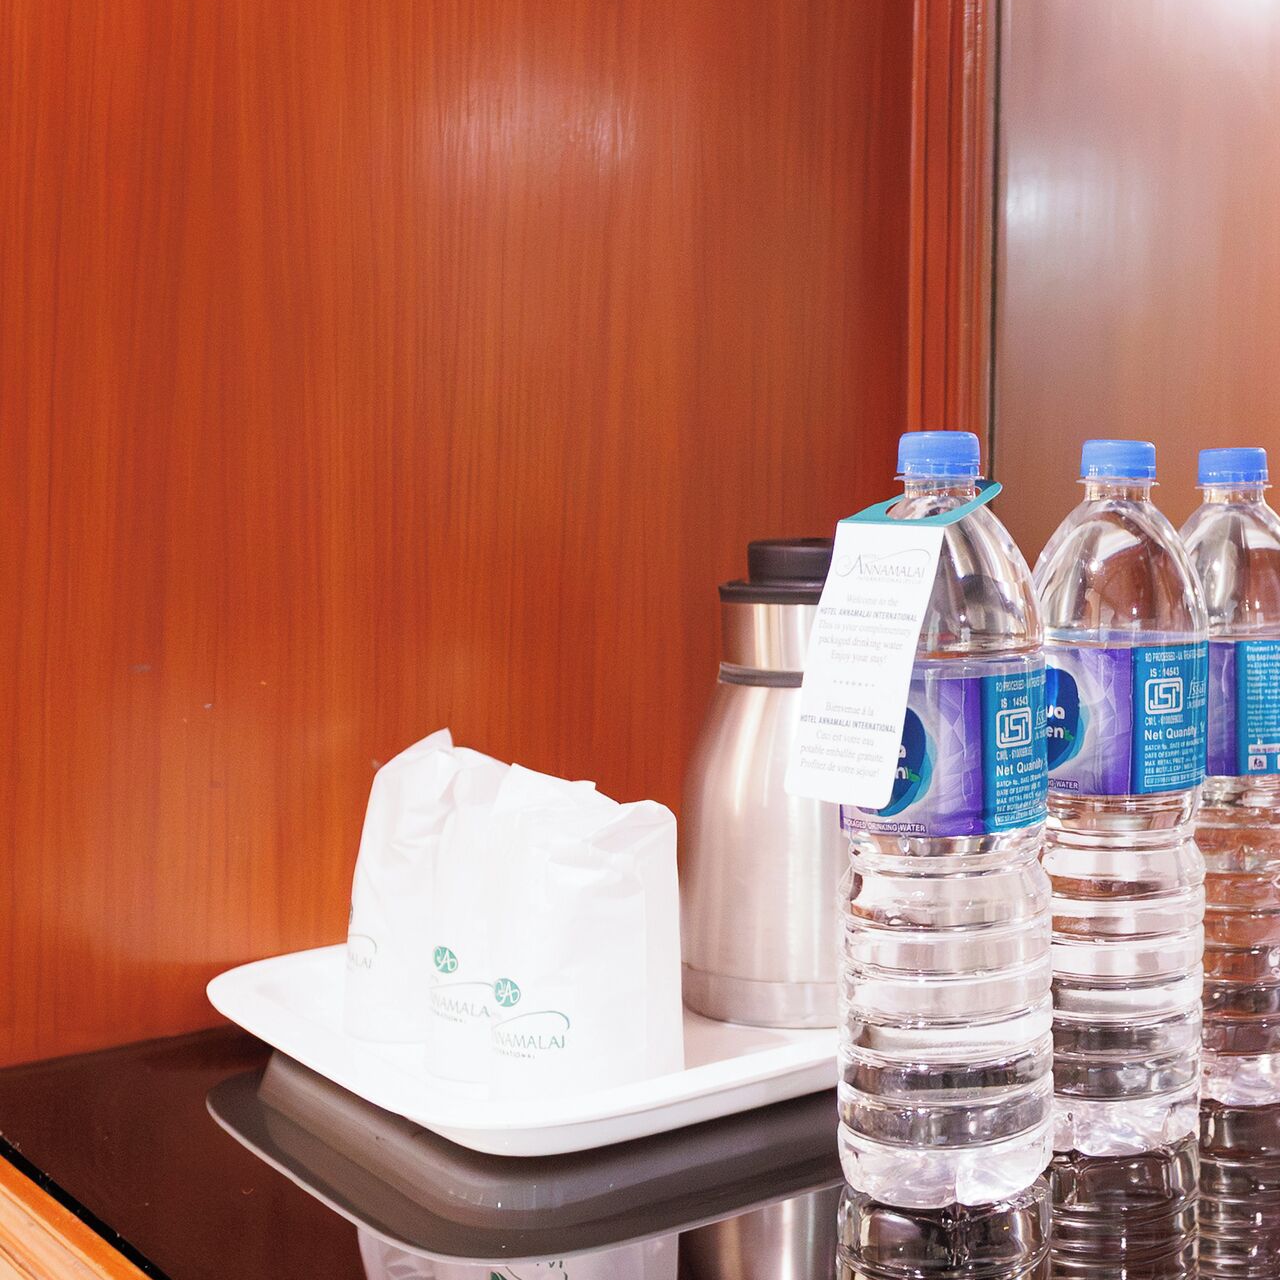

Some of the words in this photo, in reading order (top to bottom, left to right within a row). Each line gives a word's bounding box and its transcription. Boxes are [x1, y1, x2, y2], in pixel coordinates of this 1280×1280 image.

[835, 554, 926, 578] ANNAMALAI
[820, 607, 837, 616] HOTEL
[839, 609, 872, 618] ANNAMALAI
[873, 611, 918, 622] INTERNATIONAL
[852, 637, 882, 650] drinking
[1150, 668, 1157, 678] IS
[1162, 666, 1180, 677] 14543
[1045, 704, 1066, 720] ua
[800, 714, 817, 724] HOTEL
[818, 717, 851, 727] ANNAMALAI
[852, 720, 896, 733] INTERNATIONAL
[1046, 725, 1065, 739] een
[1144, 729, 1164, 741] Net
[1166, 723, 1197, 738] Quantity
[996, 764, 1014, 776] Net
[1016, 757, 1043, 773] Quantity
[1056, 780, 1078, 790] WATER
[869, 821, 899, 832] DRINKING
[900, 823, 926, 833] WATER
